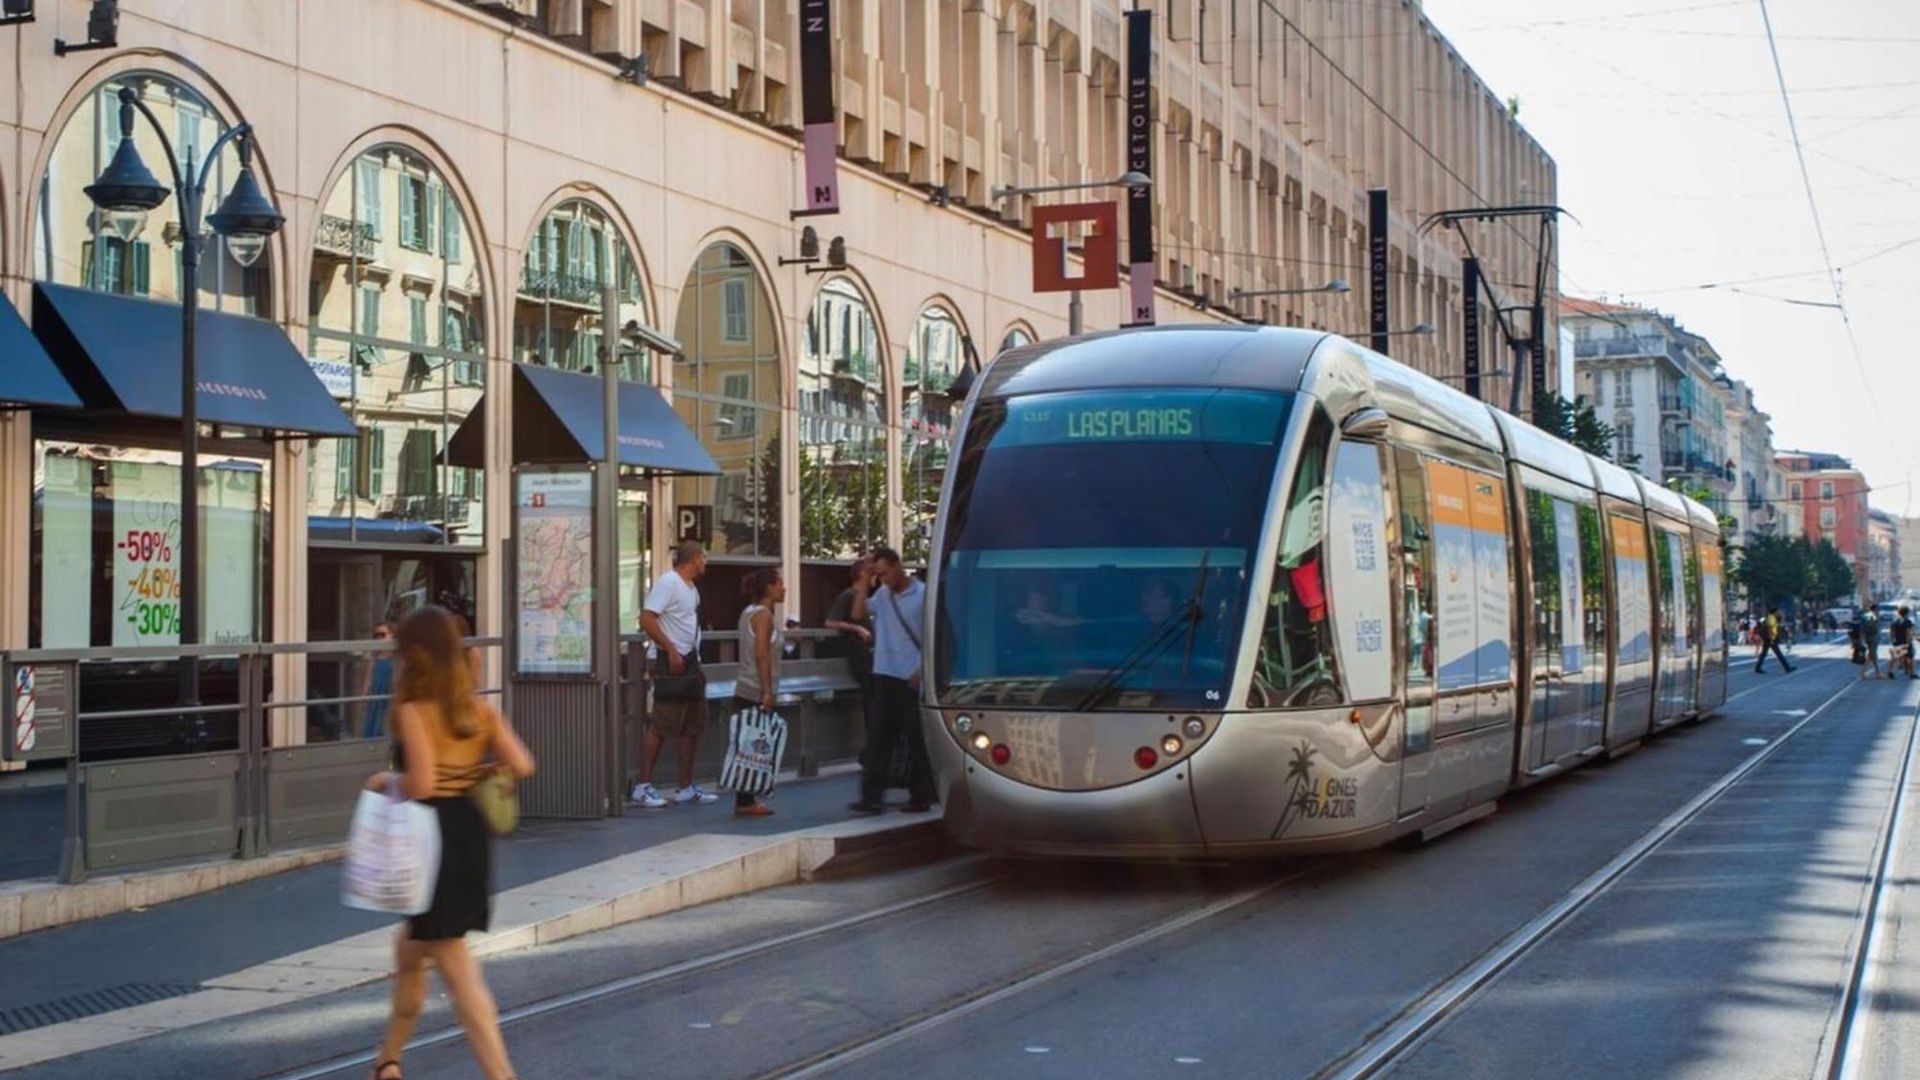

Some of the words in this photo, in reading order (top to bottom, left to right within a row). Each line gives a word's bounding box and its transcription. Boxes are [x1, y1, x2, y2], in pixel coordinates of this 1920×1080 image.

[1132, 77, 1146, 198] NCETOILE
[1045, 219, 1104, 279] T
[195, 381, 267, 401] ICETOILE
[1068, 411, 1107, 438] LAS
[1111, 408, 1193, 437] PLANAS
[680, 510, 696, 539] P
[117, 529, 171, 563] -50%
[128, 567, 181, 599] -40%
[127, 603, 181, 635] -30%
